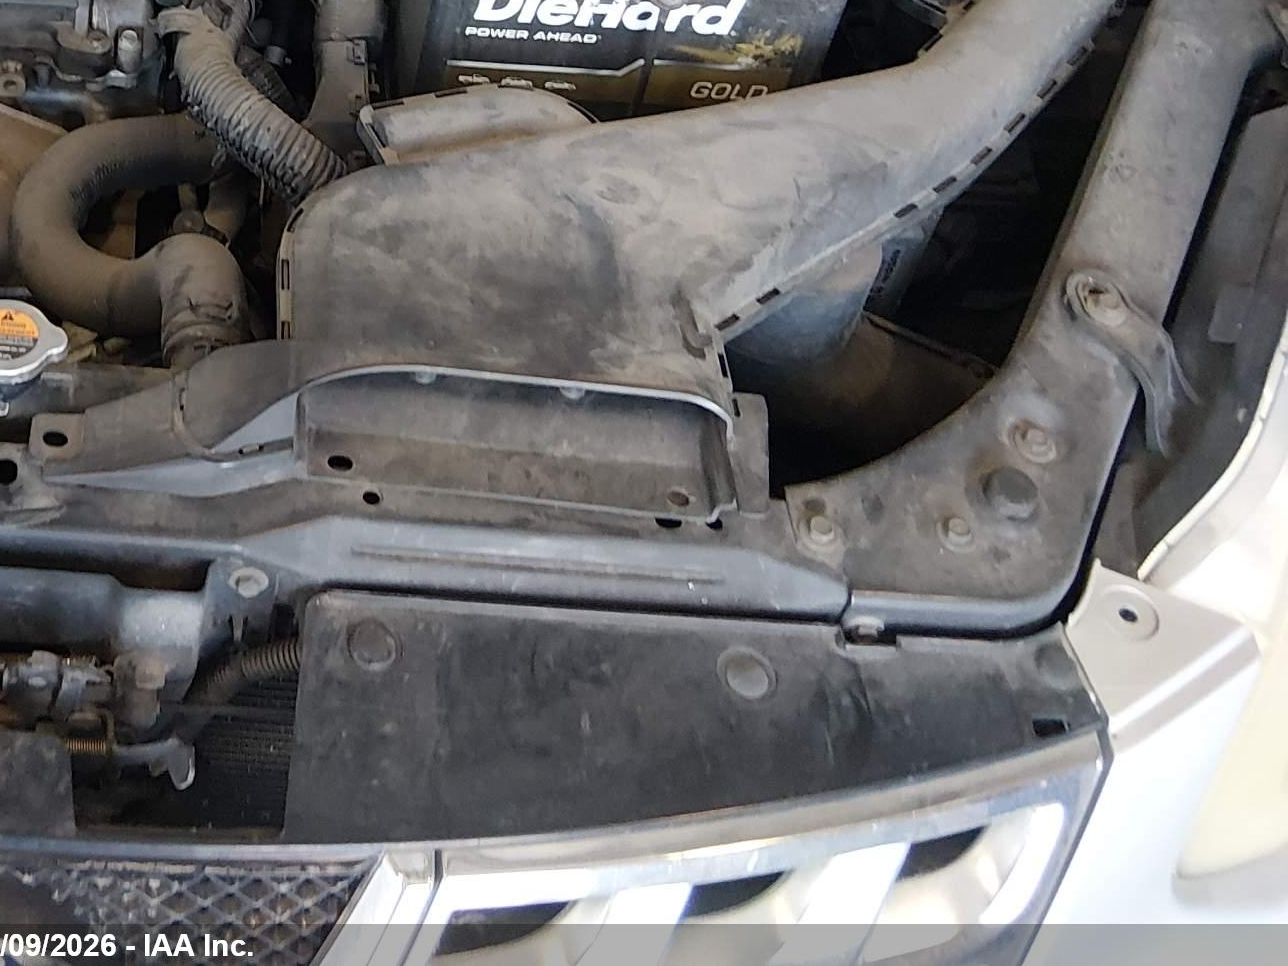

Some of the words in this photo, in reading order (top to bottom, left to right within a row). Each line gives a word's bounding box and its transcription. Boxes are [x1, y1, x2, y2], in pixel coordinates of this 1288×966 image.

[465, 26, 529, 40] POWER
[533, 30, 597, 44] AHEAD
[690, 81, 768, 100] GOLD
